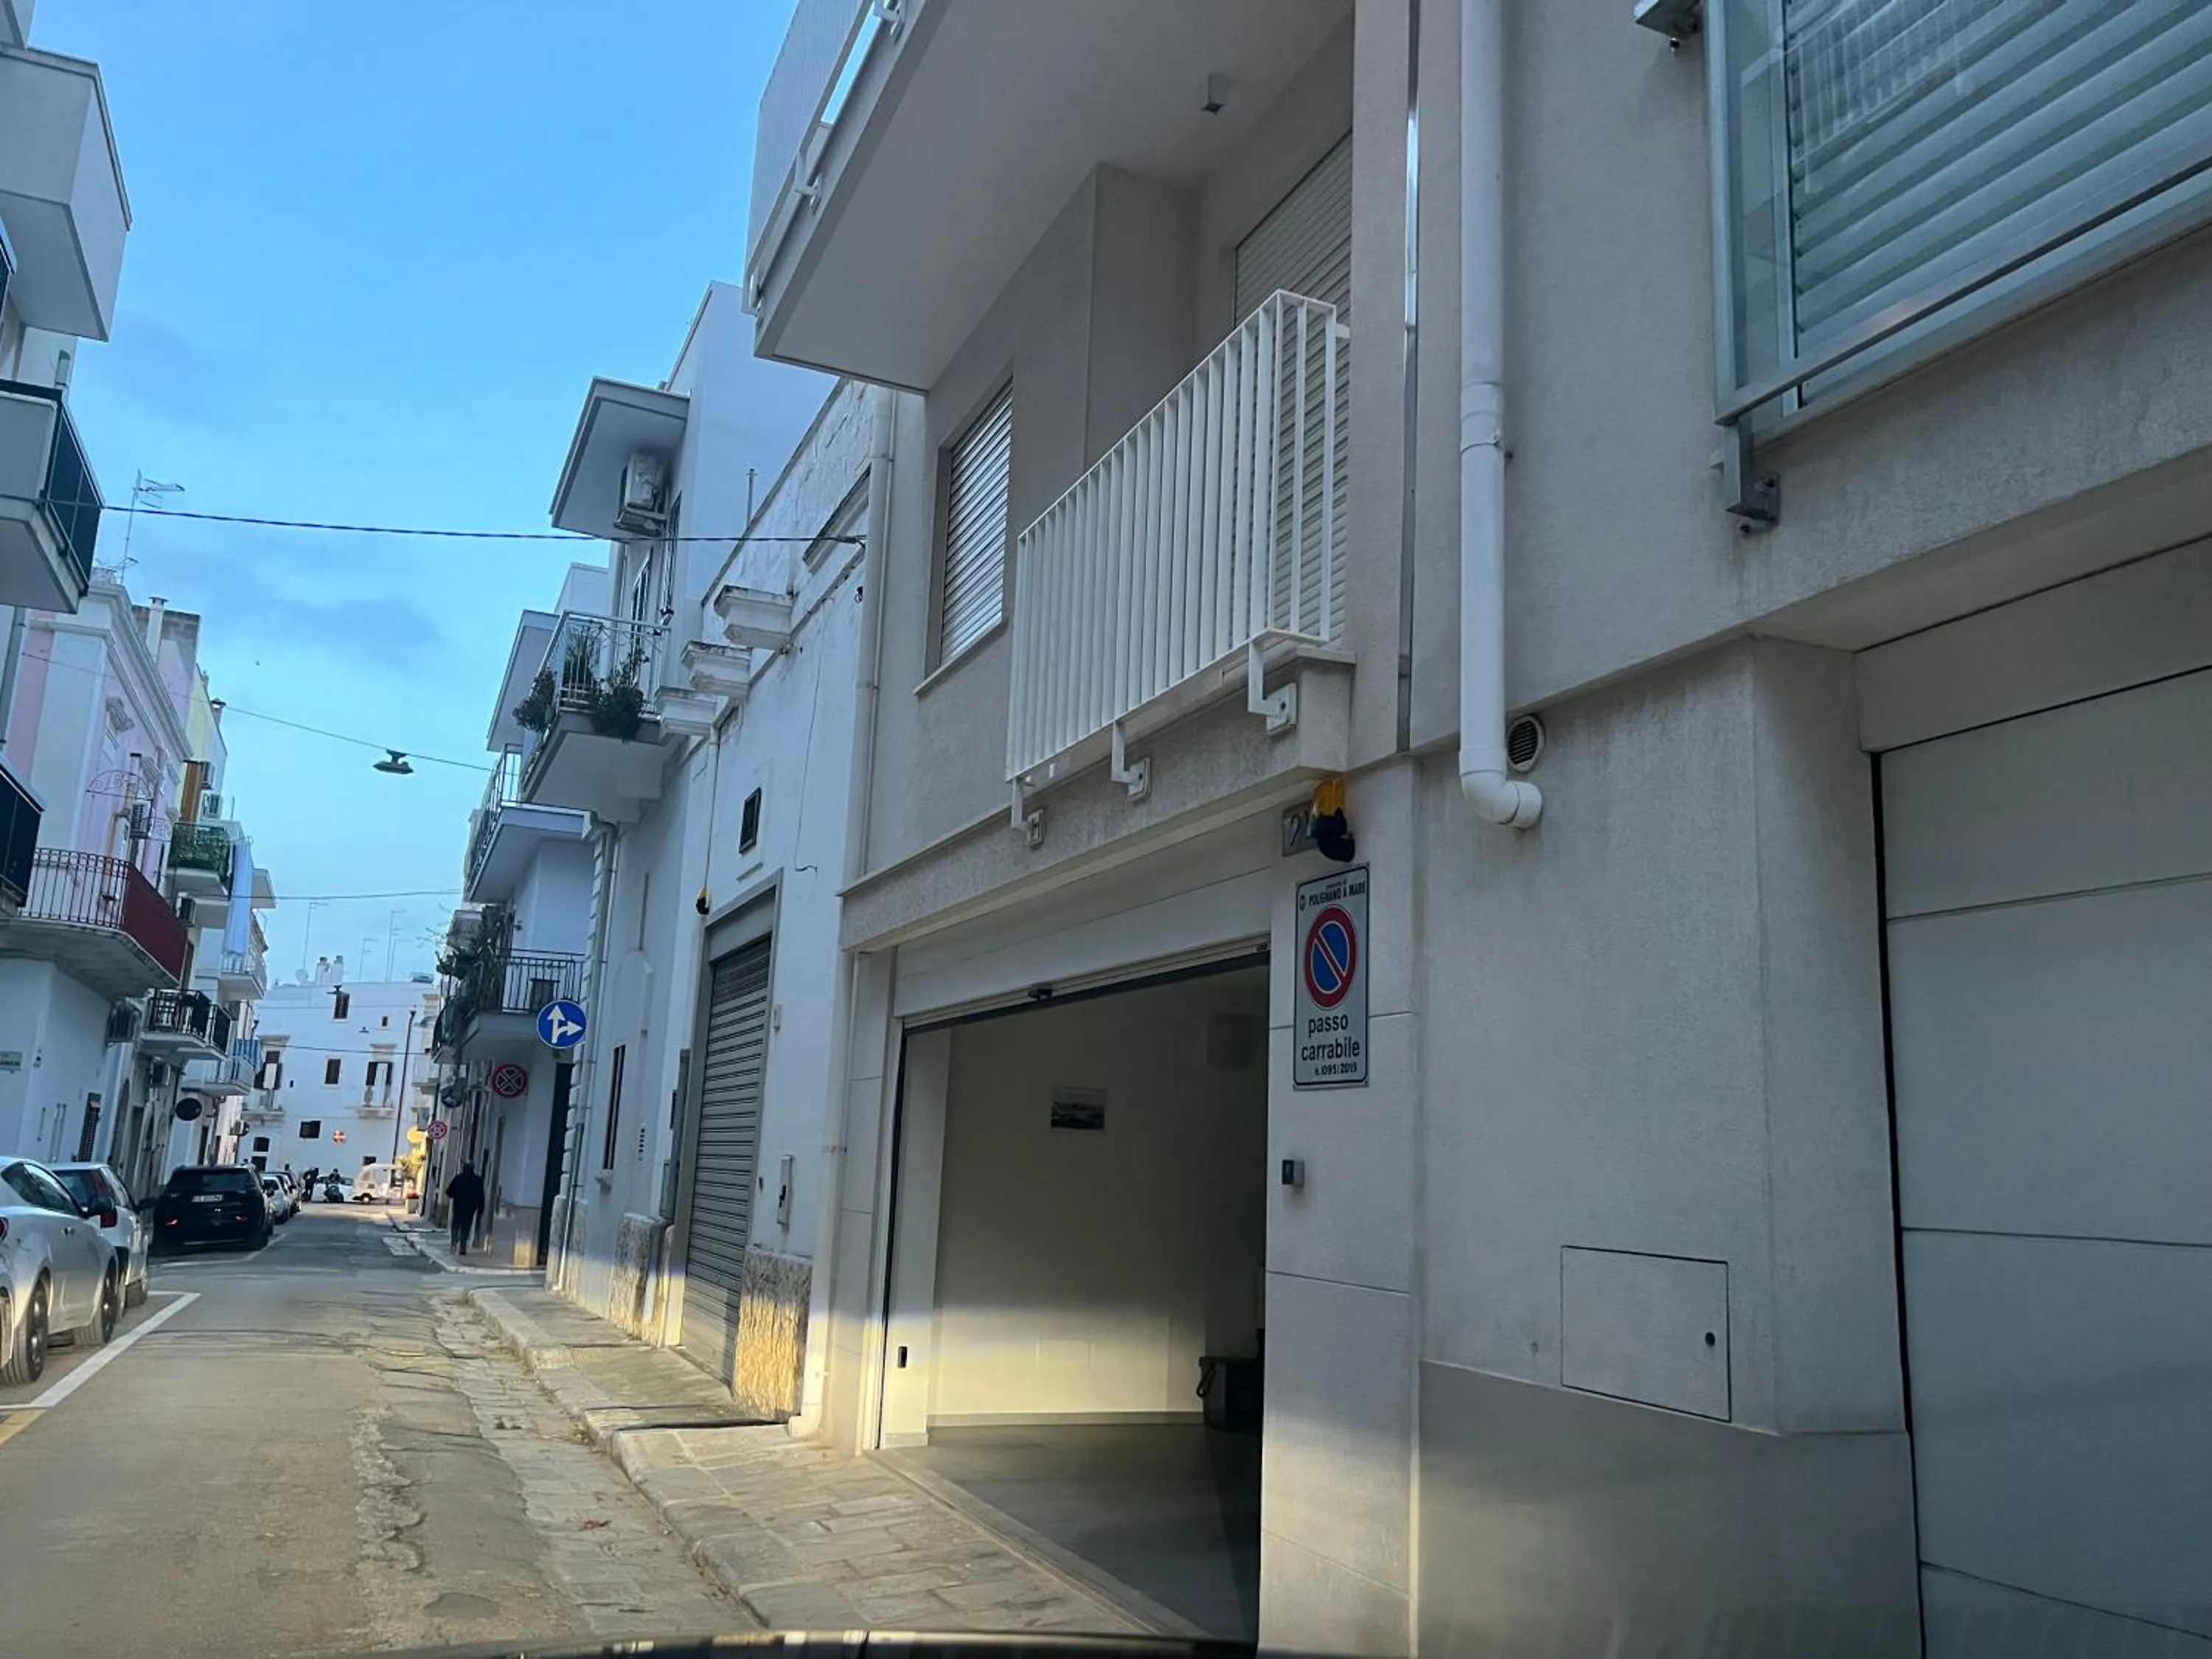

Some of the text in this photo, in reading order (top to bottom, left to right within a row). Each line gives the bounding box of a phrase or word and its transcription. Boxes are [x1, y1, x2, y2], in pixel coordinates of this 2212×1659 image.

[1349, 880, 1366, 897] MARE
[1309, 1014, 1349, 1039] passo
[1301, 1036, 1360, 1061] carrabile
